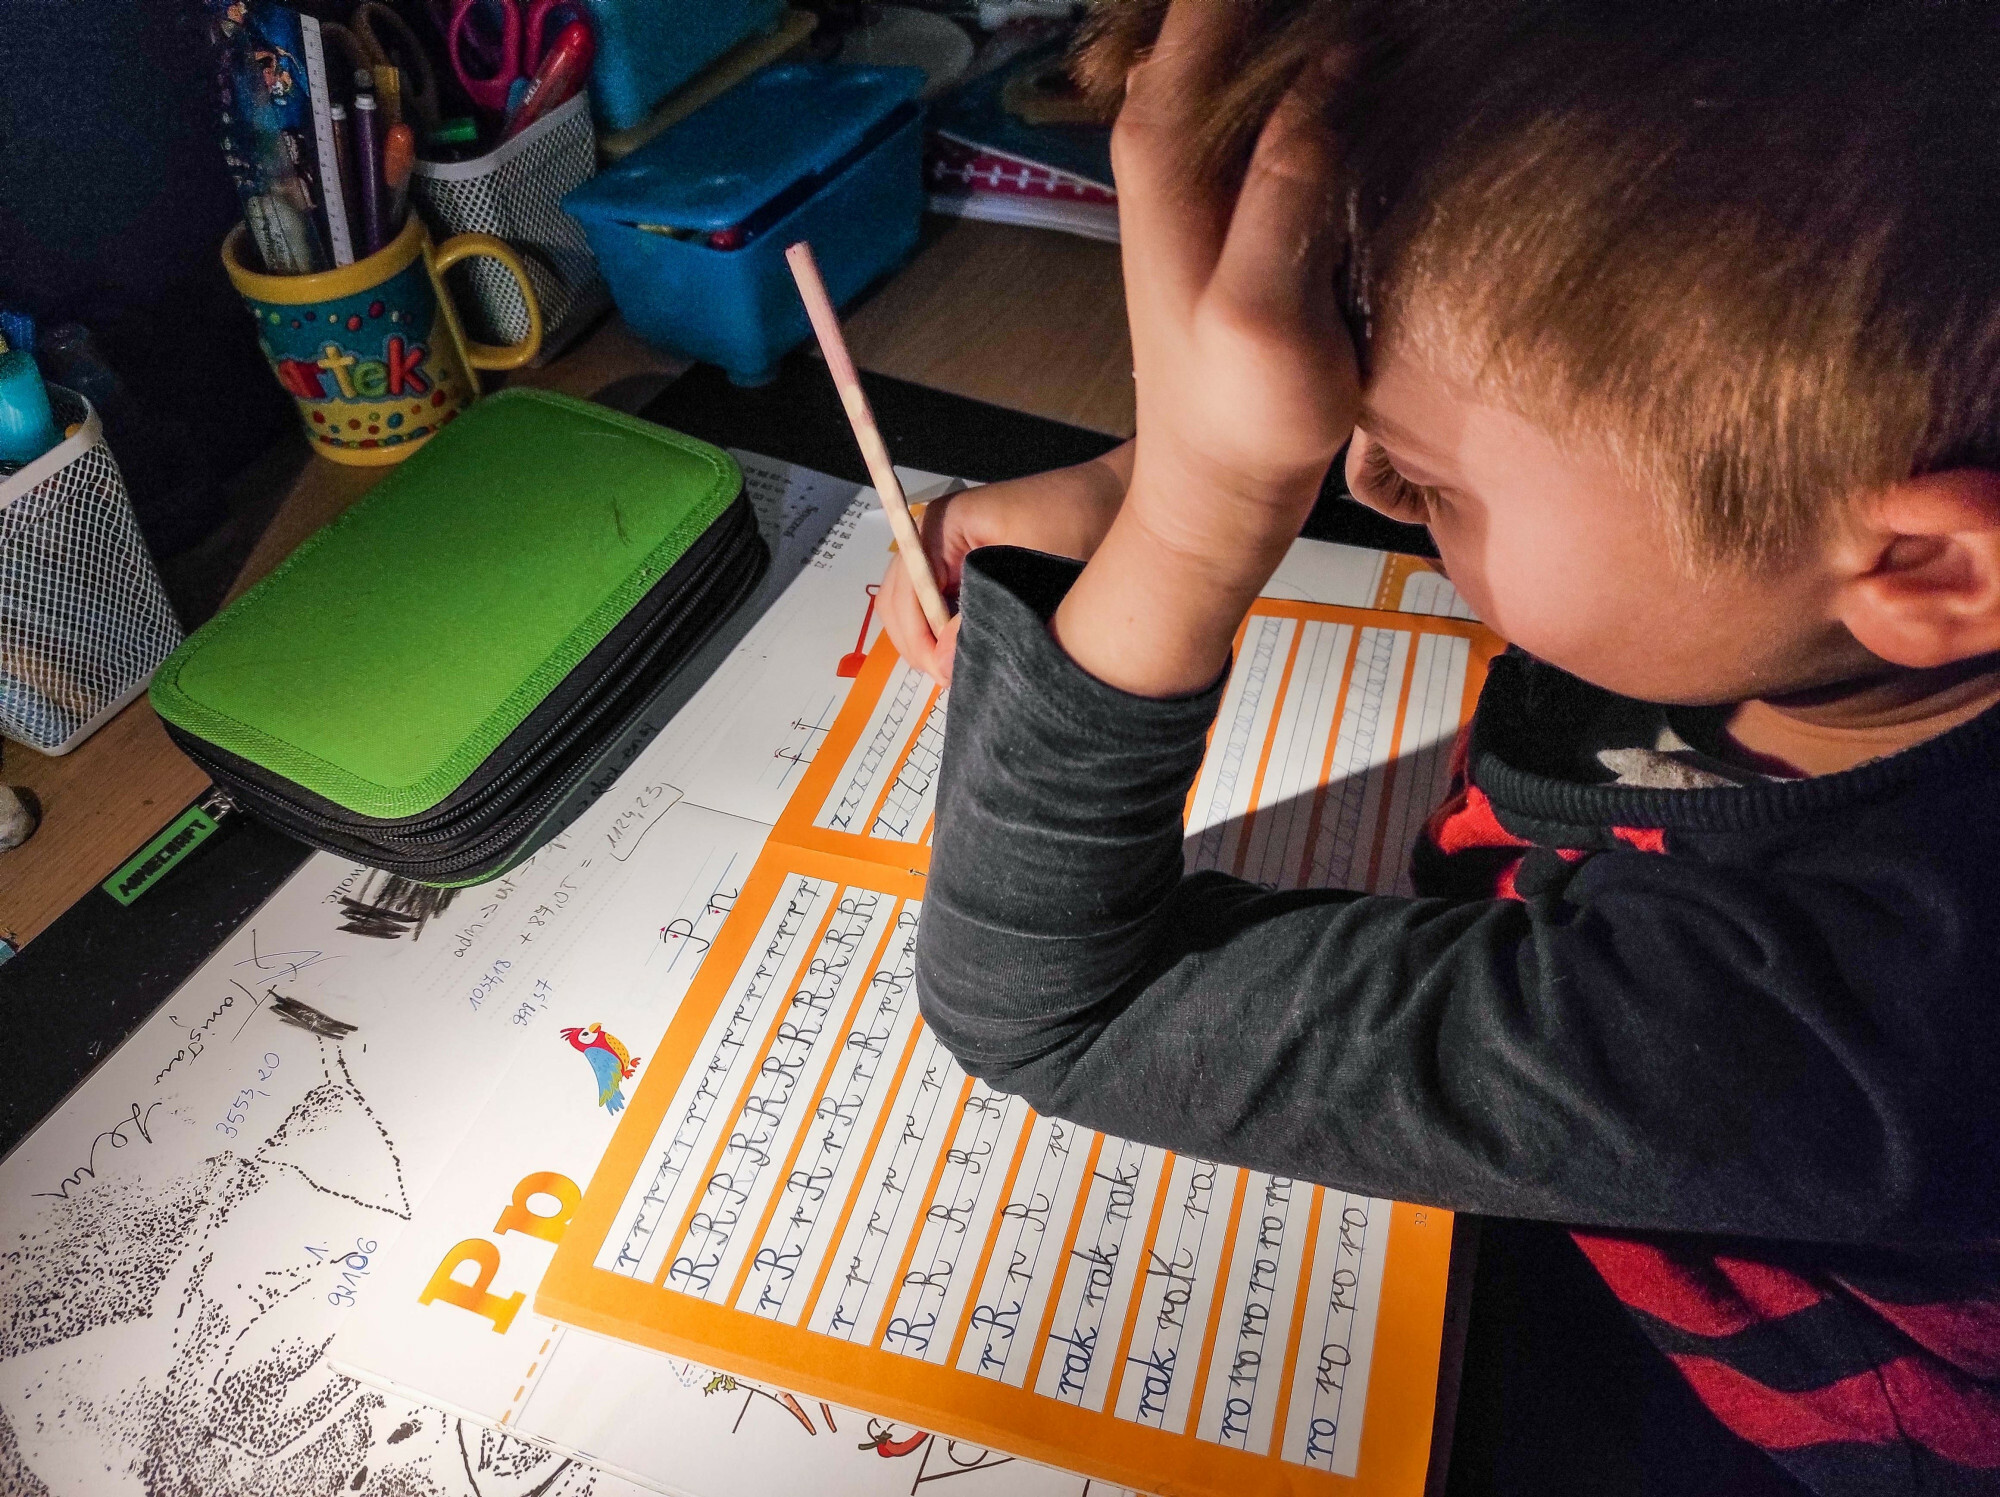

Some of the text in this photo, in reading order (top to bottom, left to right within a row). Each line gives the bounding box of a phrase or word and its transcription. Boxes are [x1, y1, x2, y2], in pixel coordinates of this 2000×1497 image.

[215, 1052, 281, 1139] 3553,20
[690, 1210, 737, 1245] R
[1259, 1216, 1283, 1249] ro
[1415, 1212, 1427, 1227] 32
[417, 1171, 583, 1335] Pp
[754, 1244, 803, 1280] R
[328, 1237, 377, 1308] 921,06
[670, 1254, 720, 1290] R
[1049, 1163, 1139, 1395] rak rak rak
[1127, 1348, 1176, 1418] rak
[1184, 1157, 1217, 1219] ra
[1250, 1259, 1277, 1293] ro
[760, 1285, 782, 1310] r
[1241, 1302, 1268, 1339] ro
[1307, 1207, 1367, 1460] ro ro ro ro
[1228, 1350, 1261, 1387] ro
[1222, 1398, 1250, 1439] ro
